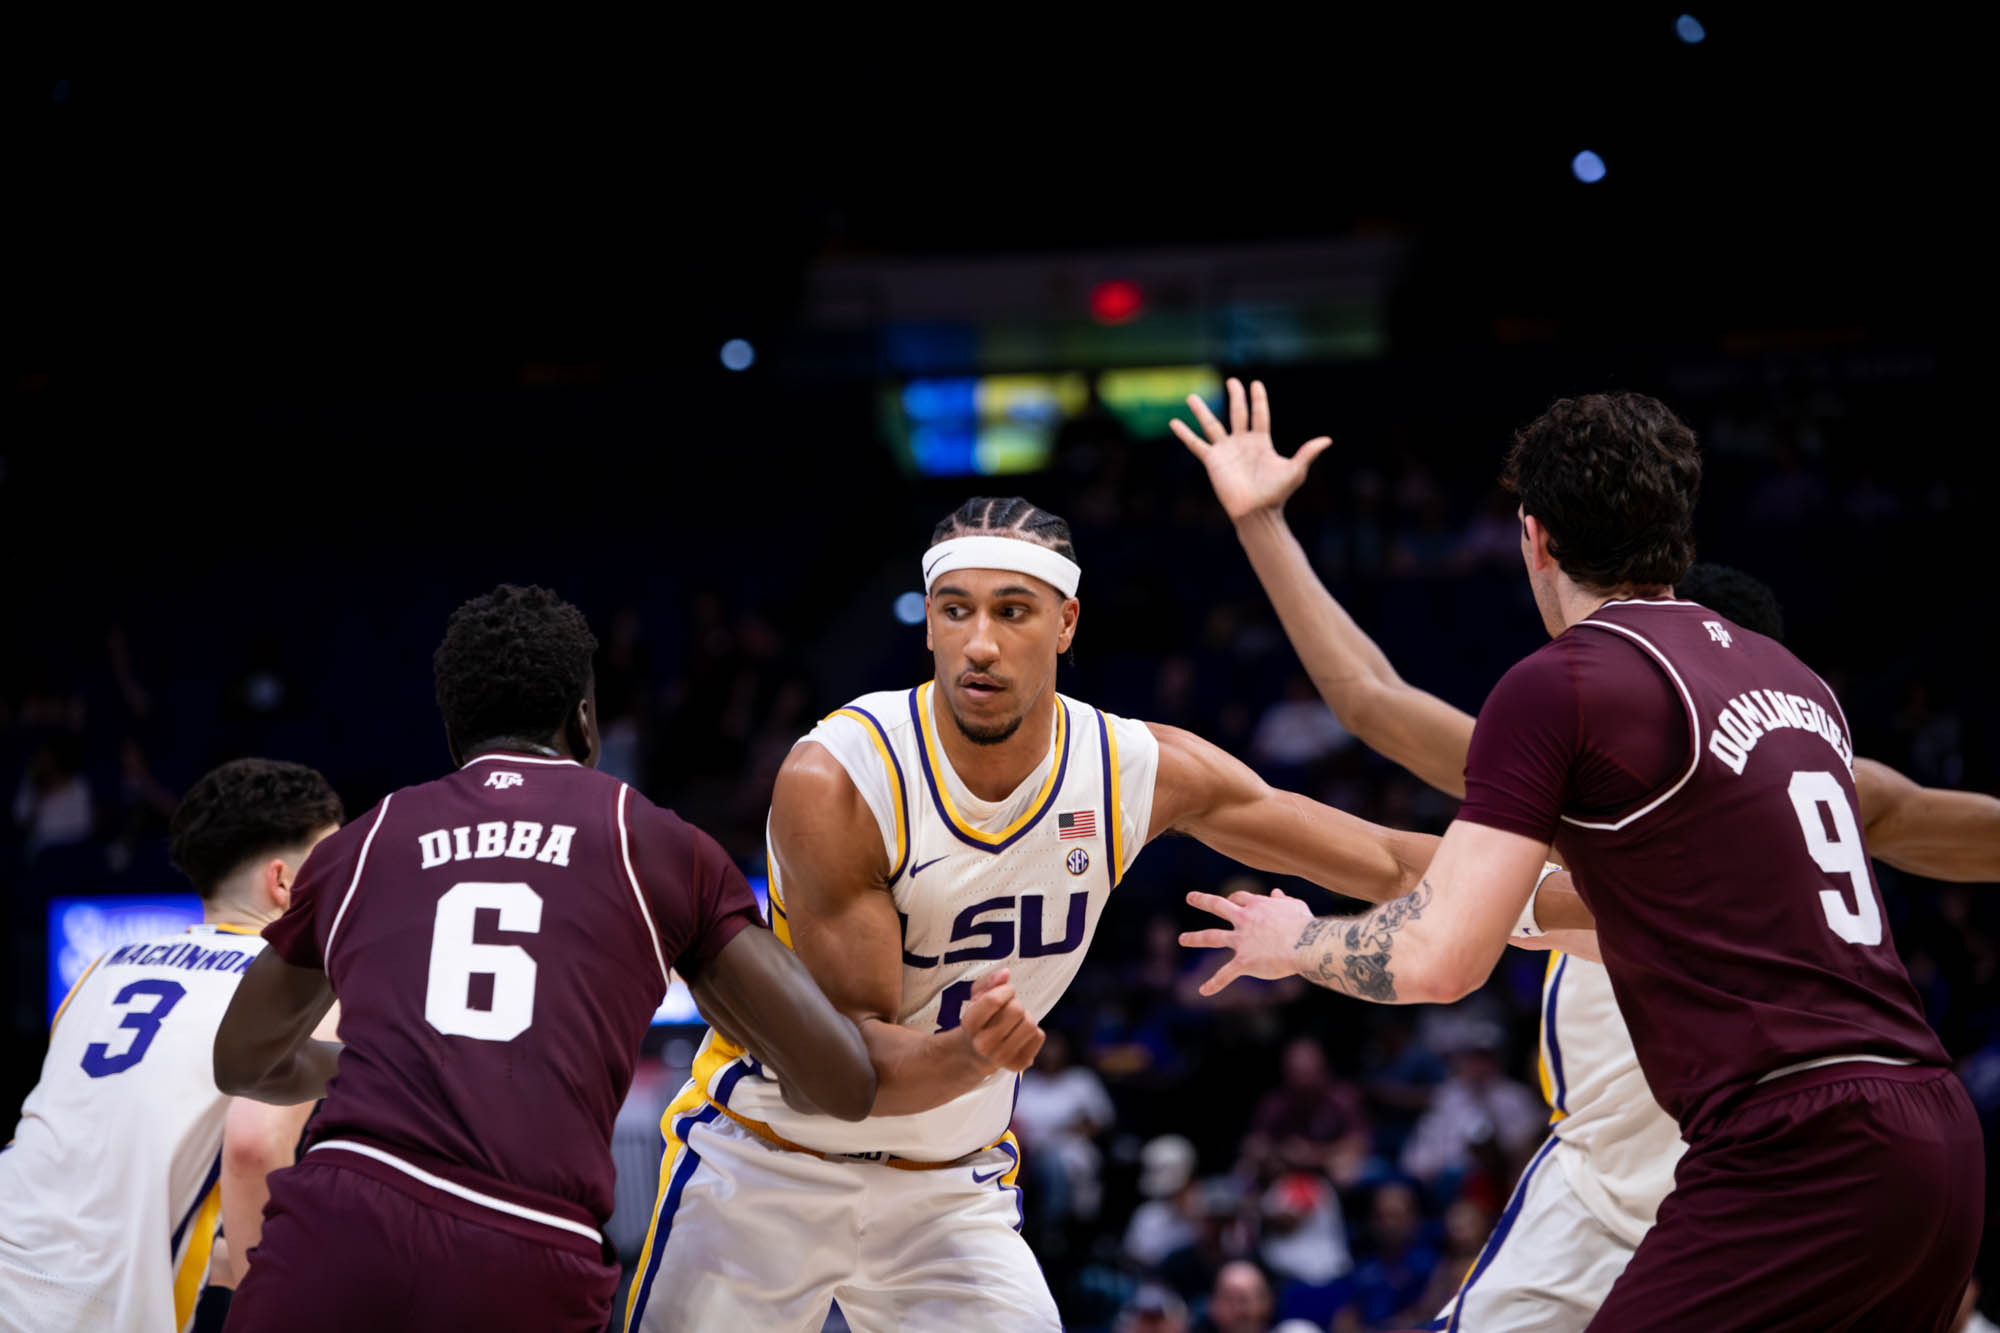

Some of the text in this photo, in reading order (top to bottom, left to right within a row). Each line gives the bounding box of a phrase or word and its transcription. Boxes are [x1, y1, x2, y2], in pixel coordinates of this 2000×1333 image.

[418, 820, 577, 870] DIBBA
[1067, 849, 1089, 874] SEC
[1787, 771, 1882, 946] 9
[425, 882, 543, 1042] 6
[80, 978, 187, 1078] 3
